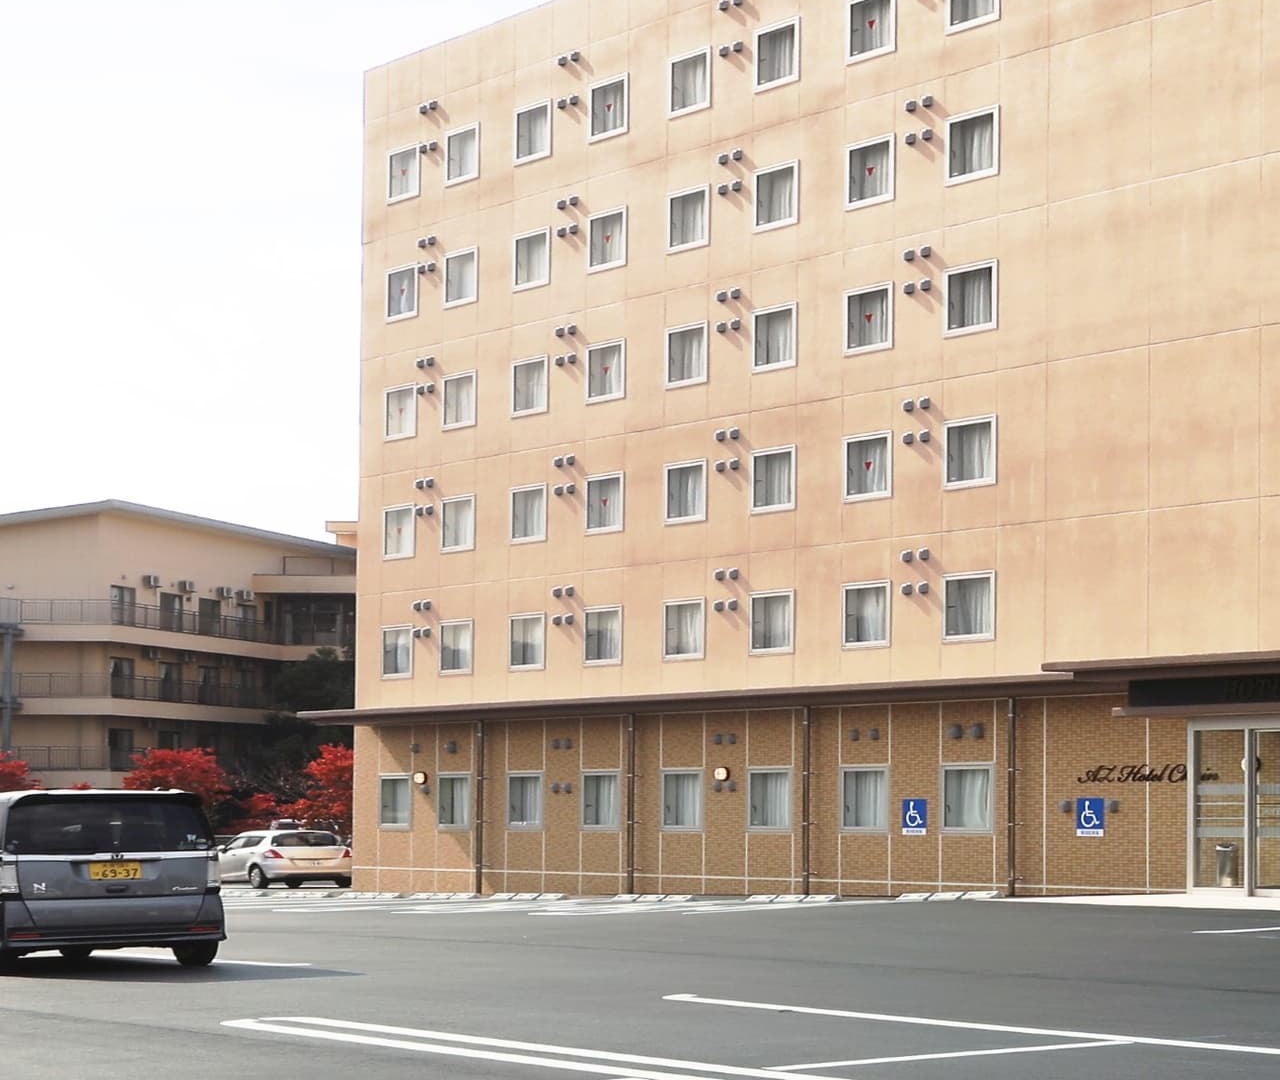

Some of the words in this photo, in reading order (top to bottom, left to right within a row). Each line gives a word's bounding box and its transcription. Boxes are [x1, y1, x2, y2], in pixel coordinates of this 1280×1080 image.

[1077, 765, 1117, 783] AZ
[1117, 764, 1170, 783] Hotel
[1168, 763, 1219, 783] Cin
